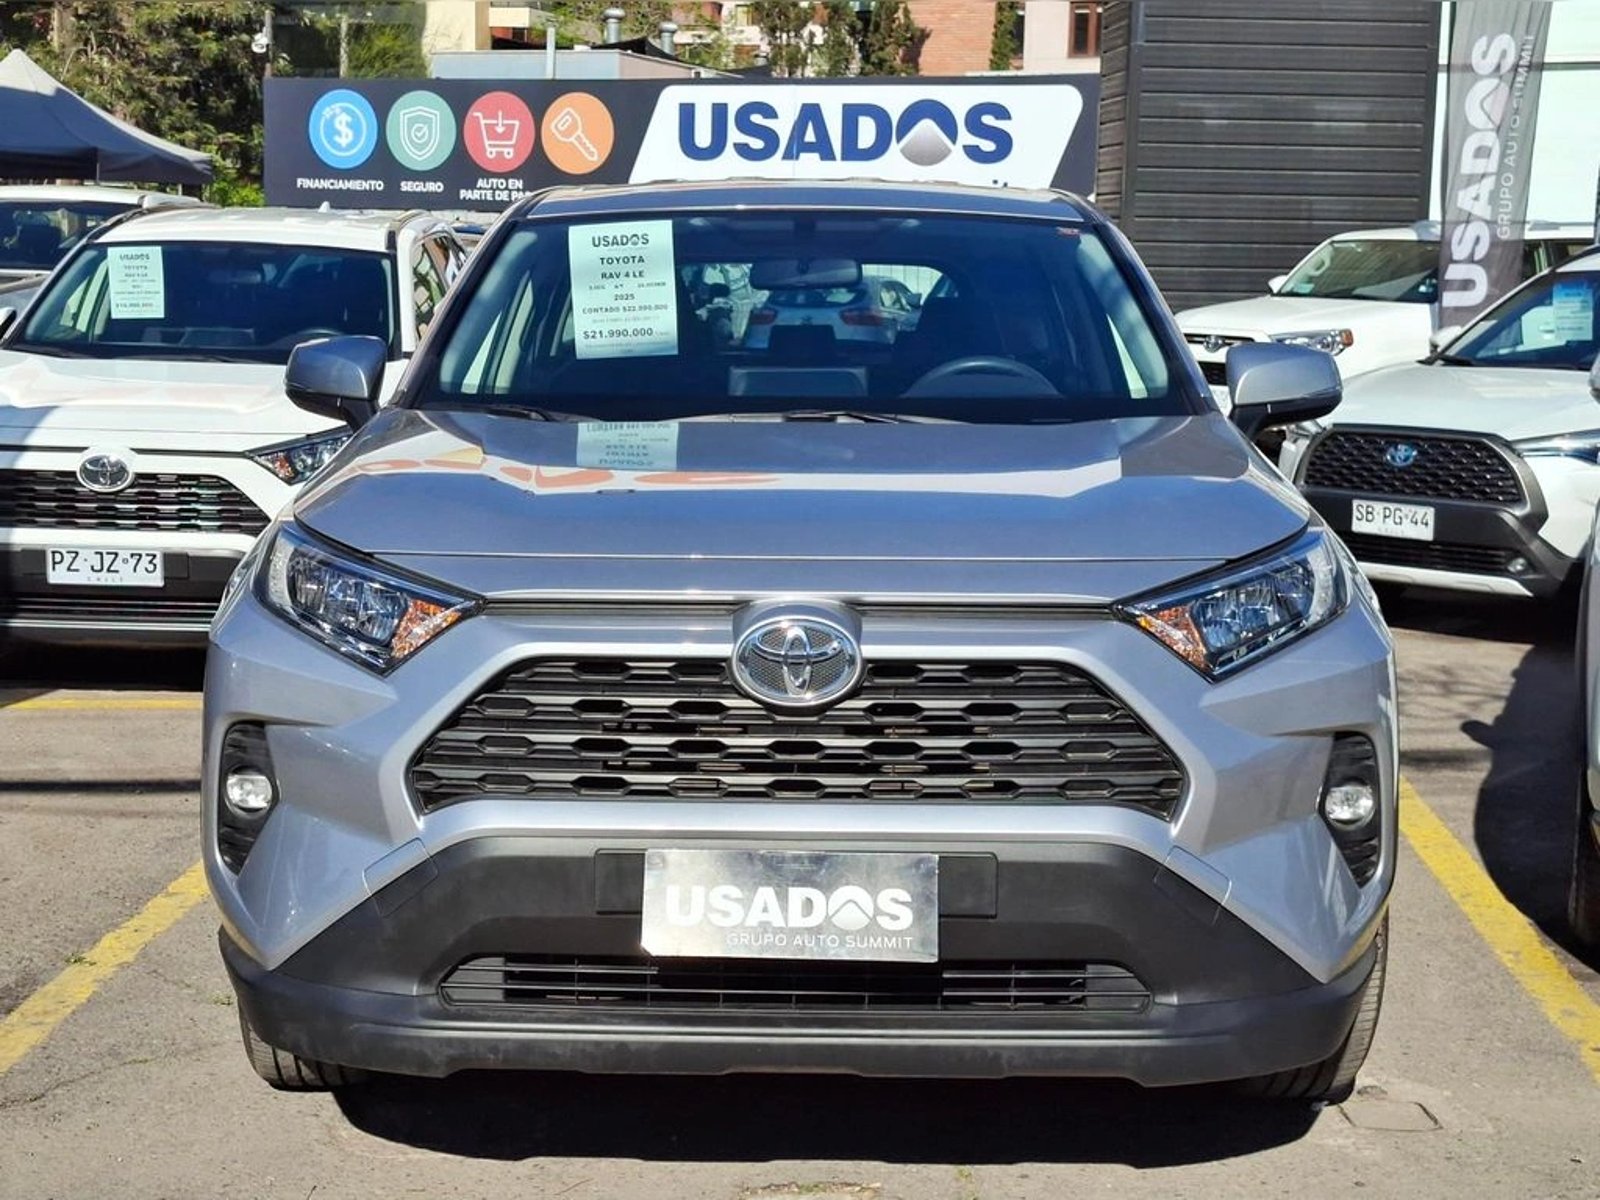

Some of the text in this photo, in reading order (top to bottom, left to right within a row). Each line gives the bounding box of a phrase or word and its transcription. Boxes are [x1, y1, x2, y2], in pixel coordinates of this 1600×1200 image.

[678, 98, 1014, 167] USADOS
[1442, 33, 1516, 308] USADOS
[297, 178, 384, 192] FINANCIAMIENTO
[401, 180, 444, 193] SEGURO
[476, 178, 523, 190] AUTO EN
[460, 189, 493, 201] PARTE
[495, 190, 509, 201] DE
[1497, 171, 1514, 240] GRUPO
[592, 233, 650, 247] USADOS
[600, 255, 645, 266] TOYOTA
[601, 271, 621, 280] RAV
[582, 306, 620, 315] CONTADO
[666, 885, 914, 930] USADOS
[726, 932, 913, 949] GRUPO AUTO SUMMIT
